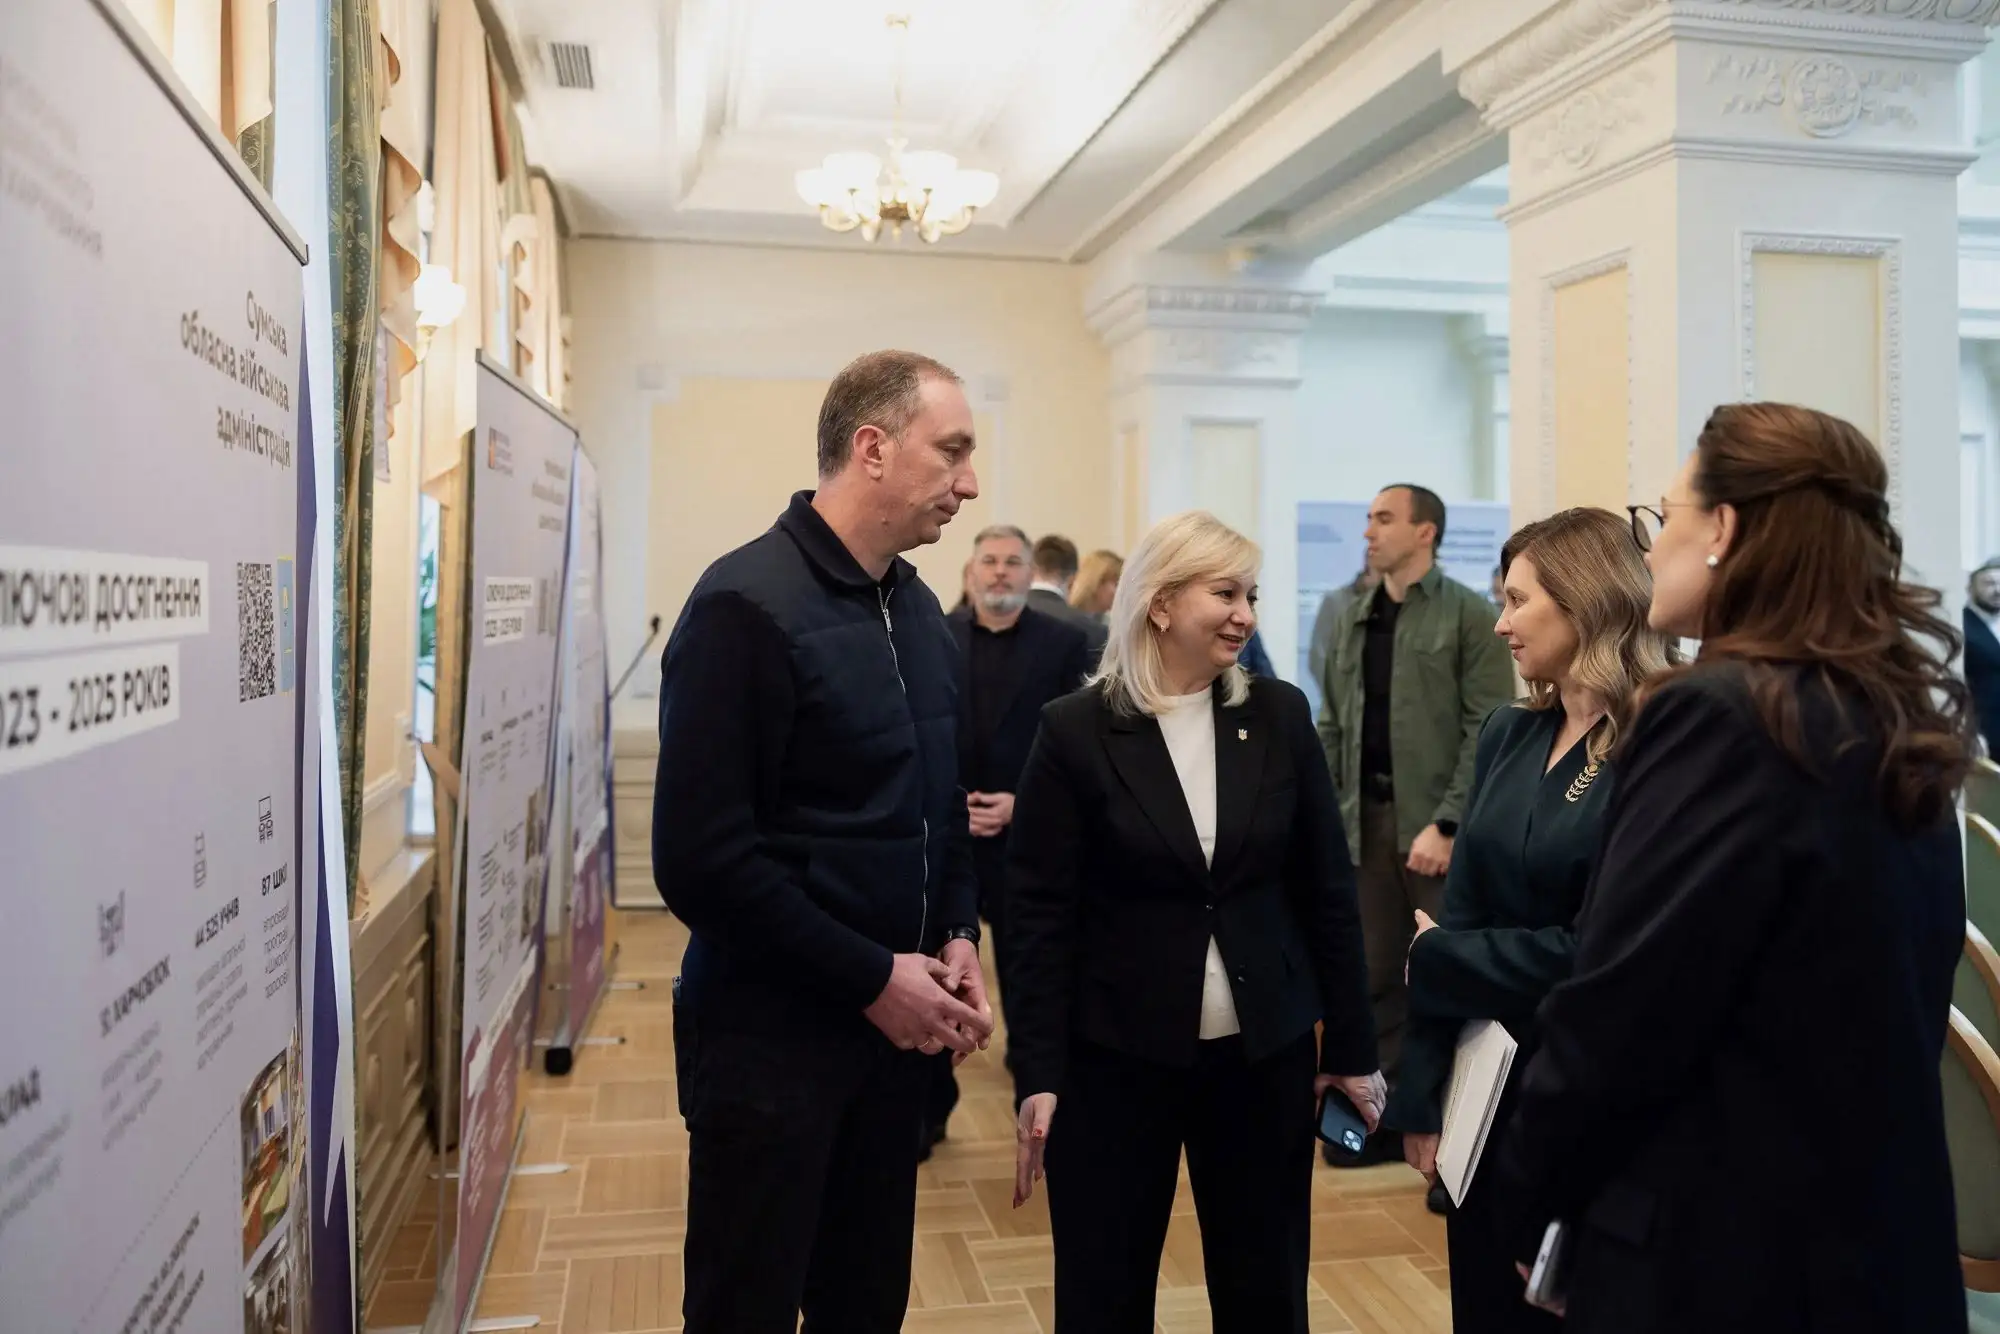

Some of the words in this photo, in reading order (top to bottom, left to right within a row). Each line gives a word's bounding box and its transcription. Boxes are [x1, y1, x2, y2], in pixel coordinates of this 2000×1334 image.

[246, 290, 288, 357] Сумська
[181, 309, 237, 381] обласна
[239, 348, 290, 412] військова
[217, 405, 291, 471] адміністрація
[94, 571, 202, 633] ДОСЯГНЕННЯ
[68, 673, 117, 733] 2025
[123, 664, 170, 718] РОКІВ
[261, 874, 271, 897] 87
